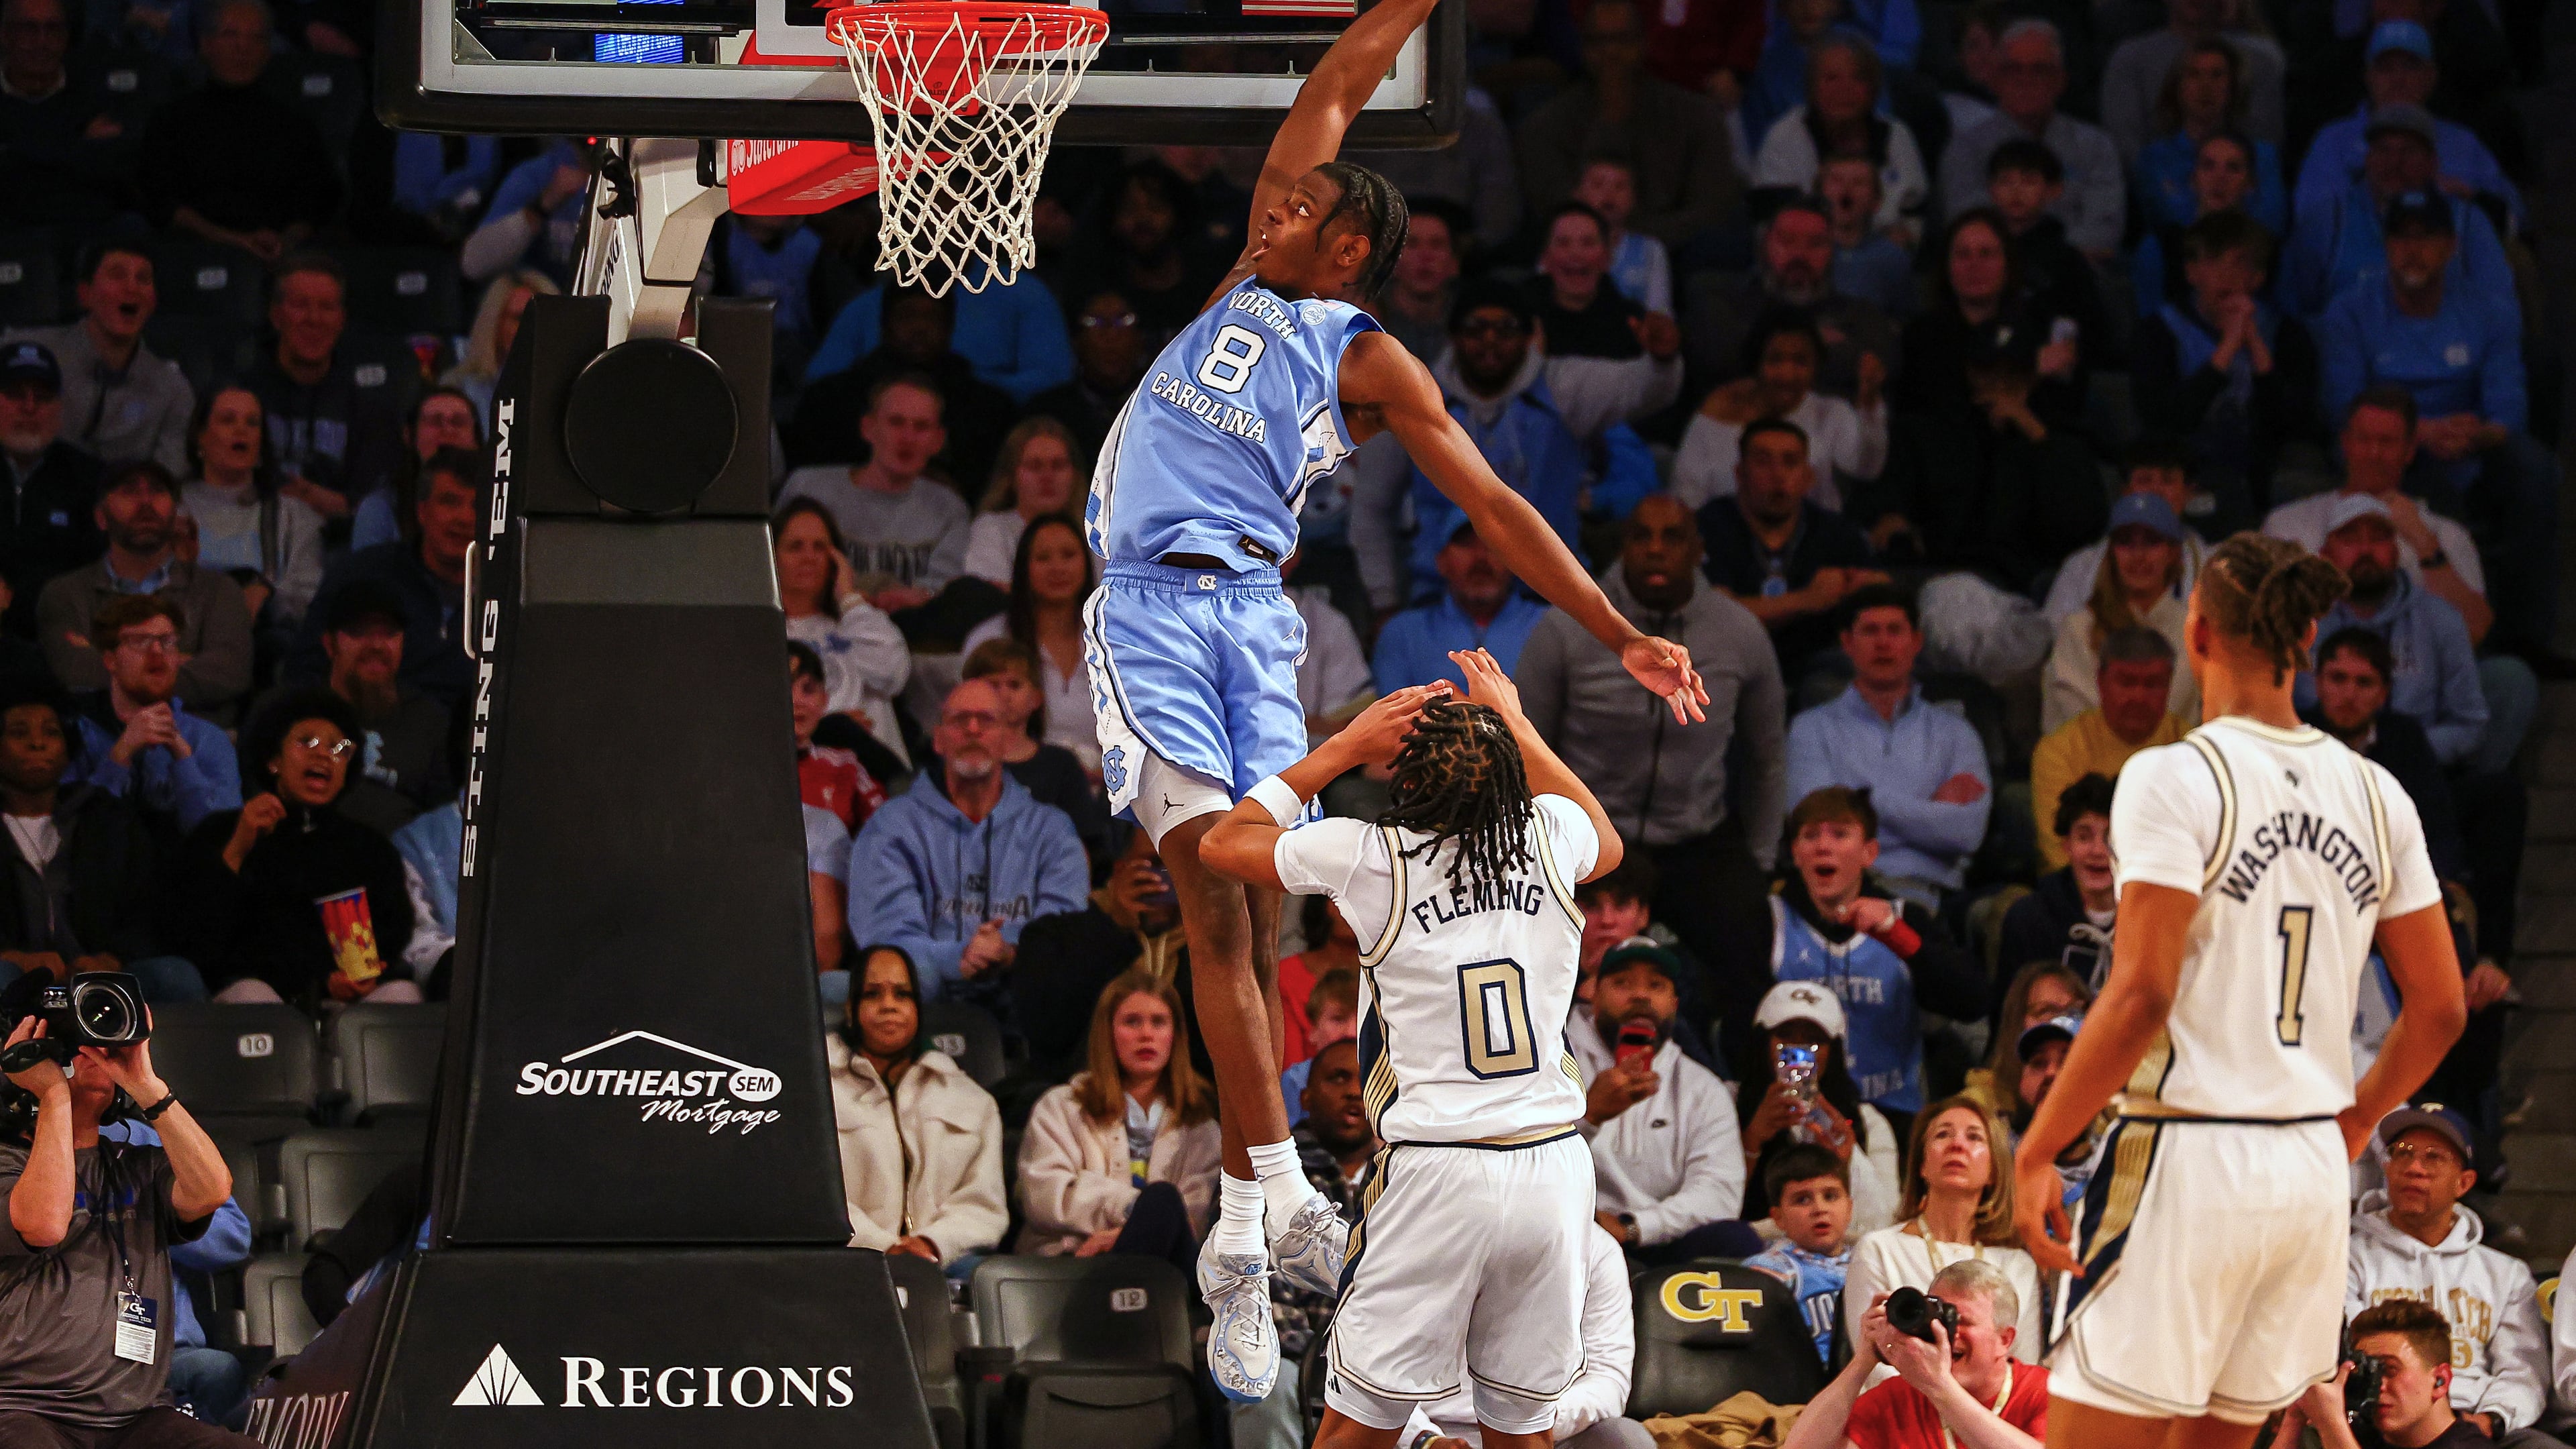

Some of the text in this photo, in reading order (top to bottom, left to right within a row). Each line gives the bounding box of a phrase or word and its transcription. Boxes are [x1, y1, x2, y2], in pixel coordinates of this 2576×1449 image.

[1226, 290, 1297, 340] NORTH
[1197, 323, 1268, 395] 8
[1150, 370, 1269, 444] CAROLINA
[462, 600, 498, 877] STING
[2276, 905, 2314, 1047] 1
[1457, 957, 1540, 1081] 0
[639, 1097, 782, 1135] Mortgage
[734, 1077, 774, 1093] SEM
[129, 1301, 146, 1316] GT
[1660, 1271, 1764, 1334] GT
[559, 1356, 855, 1408] REGIONS
